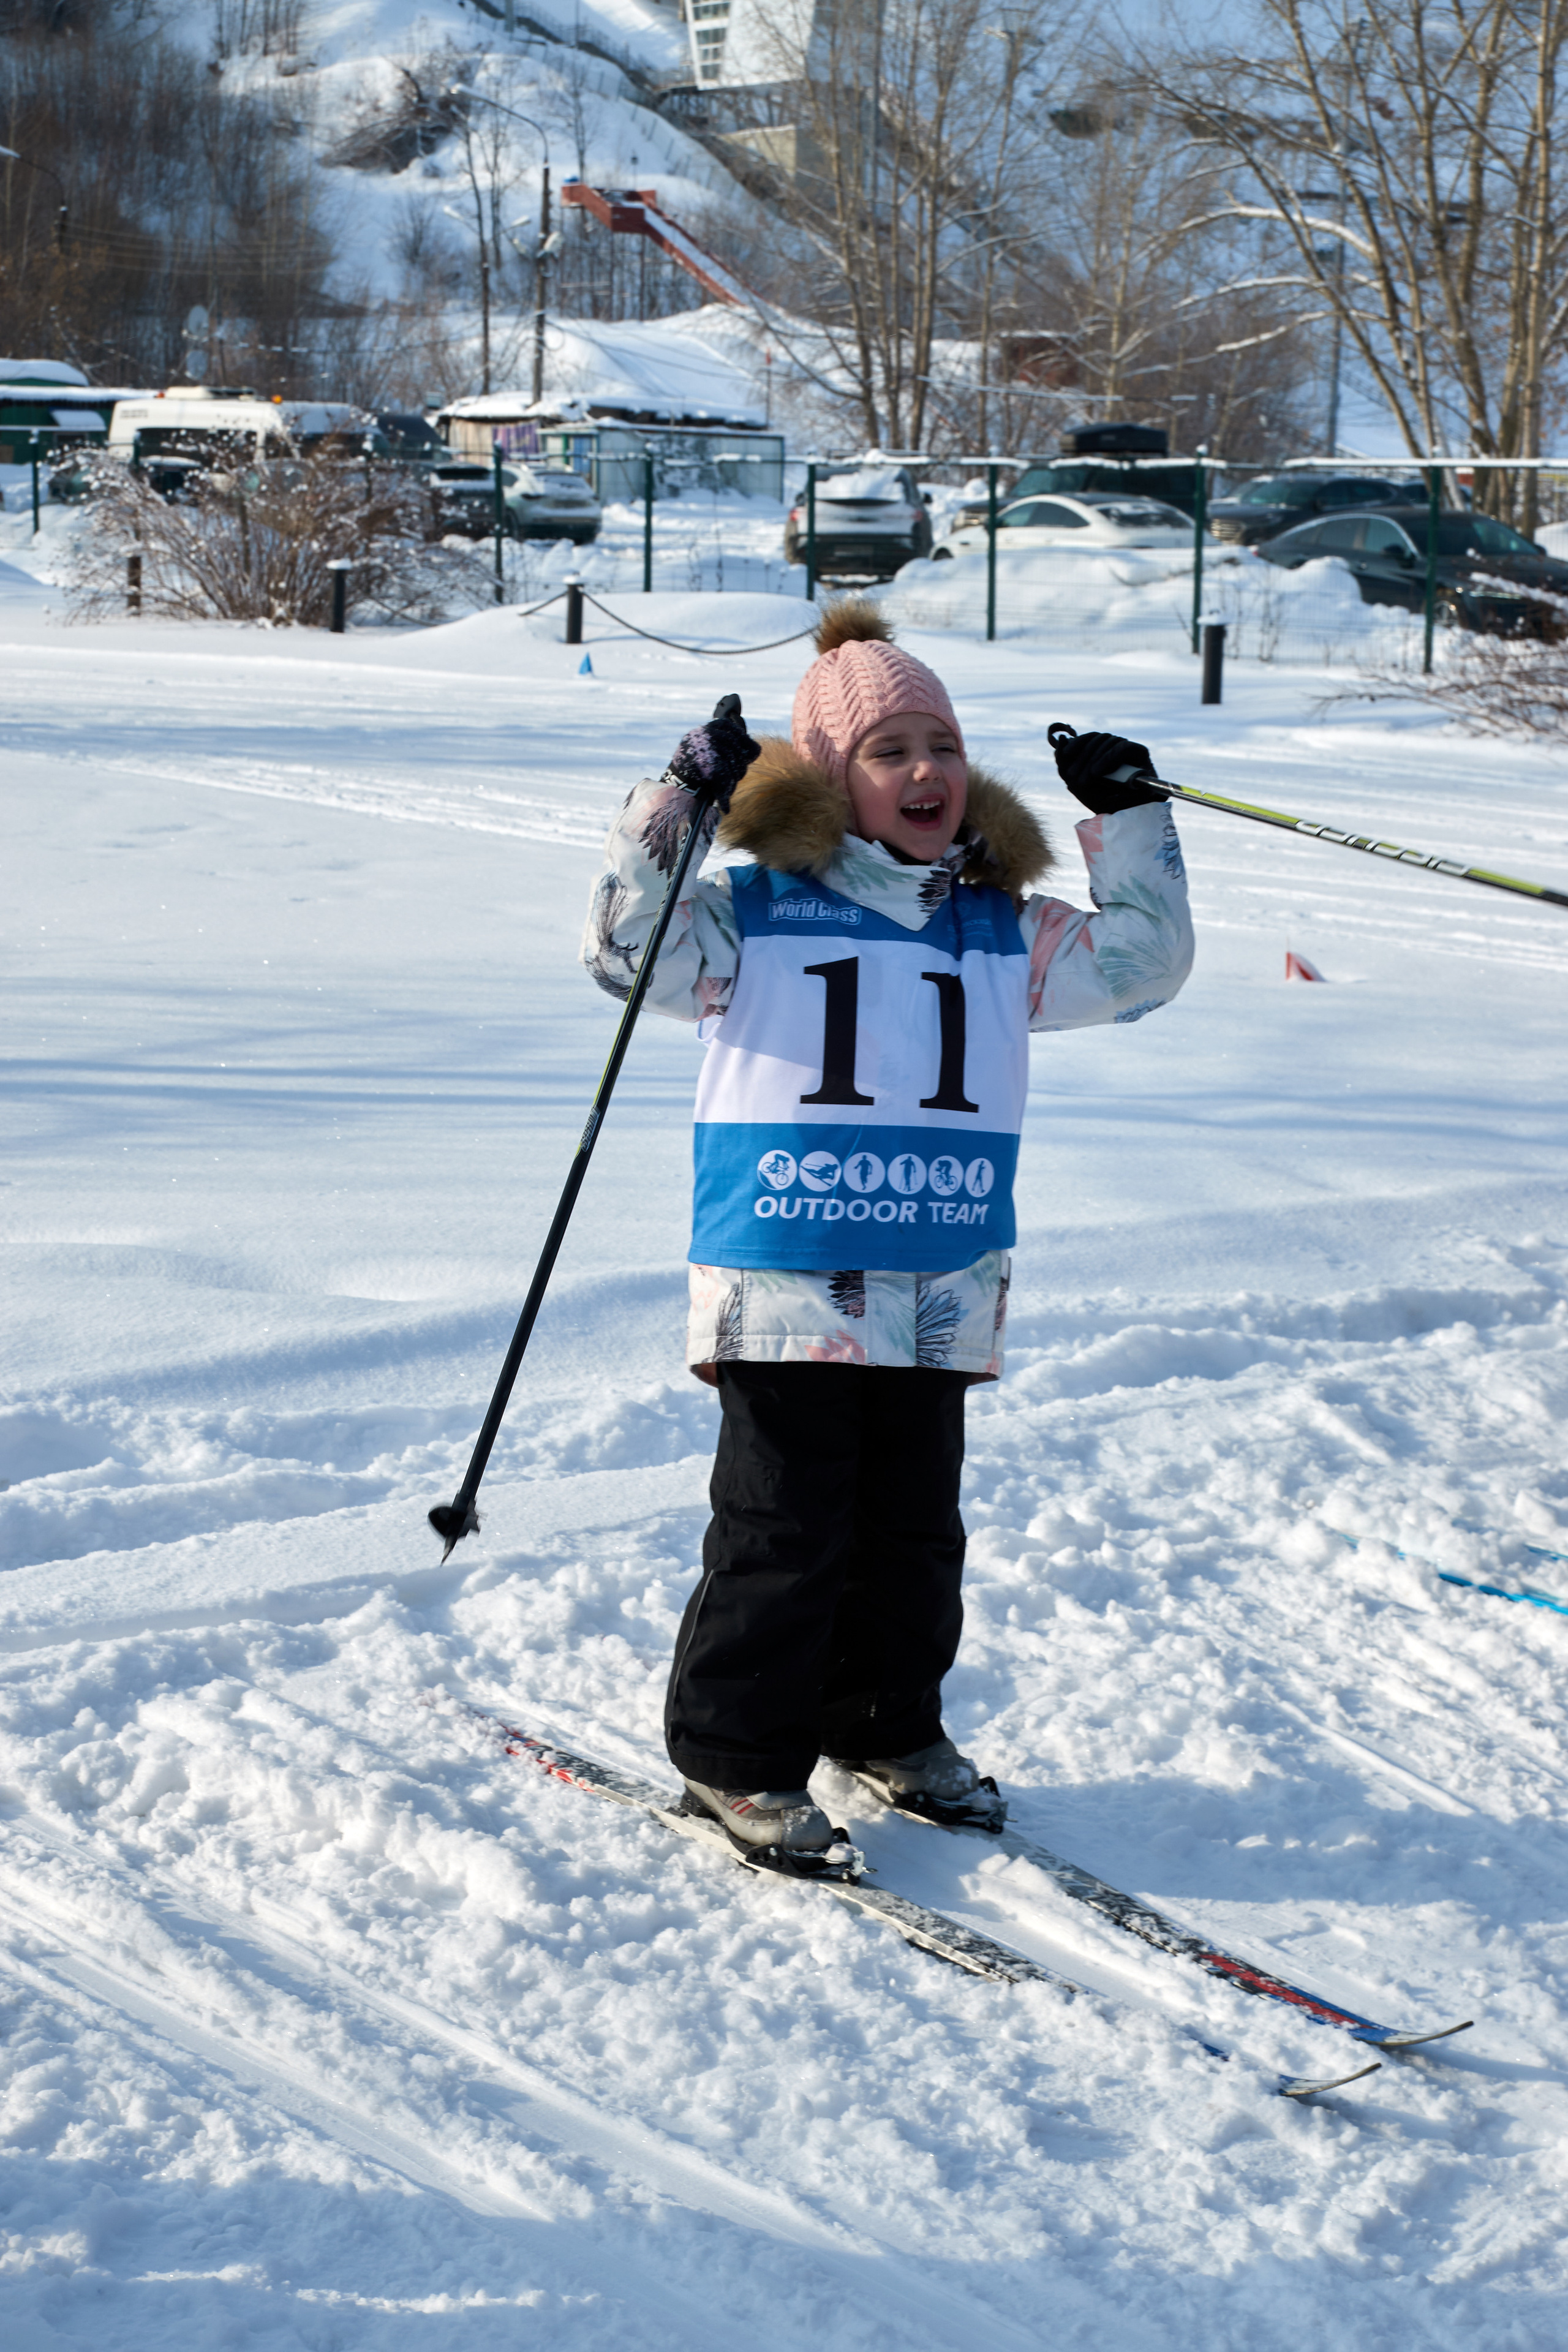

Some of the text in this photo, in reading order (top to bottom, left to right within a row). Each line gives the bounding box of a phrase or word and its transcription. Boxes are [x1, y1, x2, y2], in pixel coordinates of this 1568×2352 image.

[772, 900, 858, 922] World Class
[800, 956, 979, 1114] 11
[754, 1196, 989, 1224] OUTDOOR TEAM
